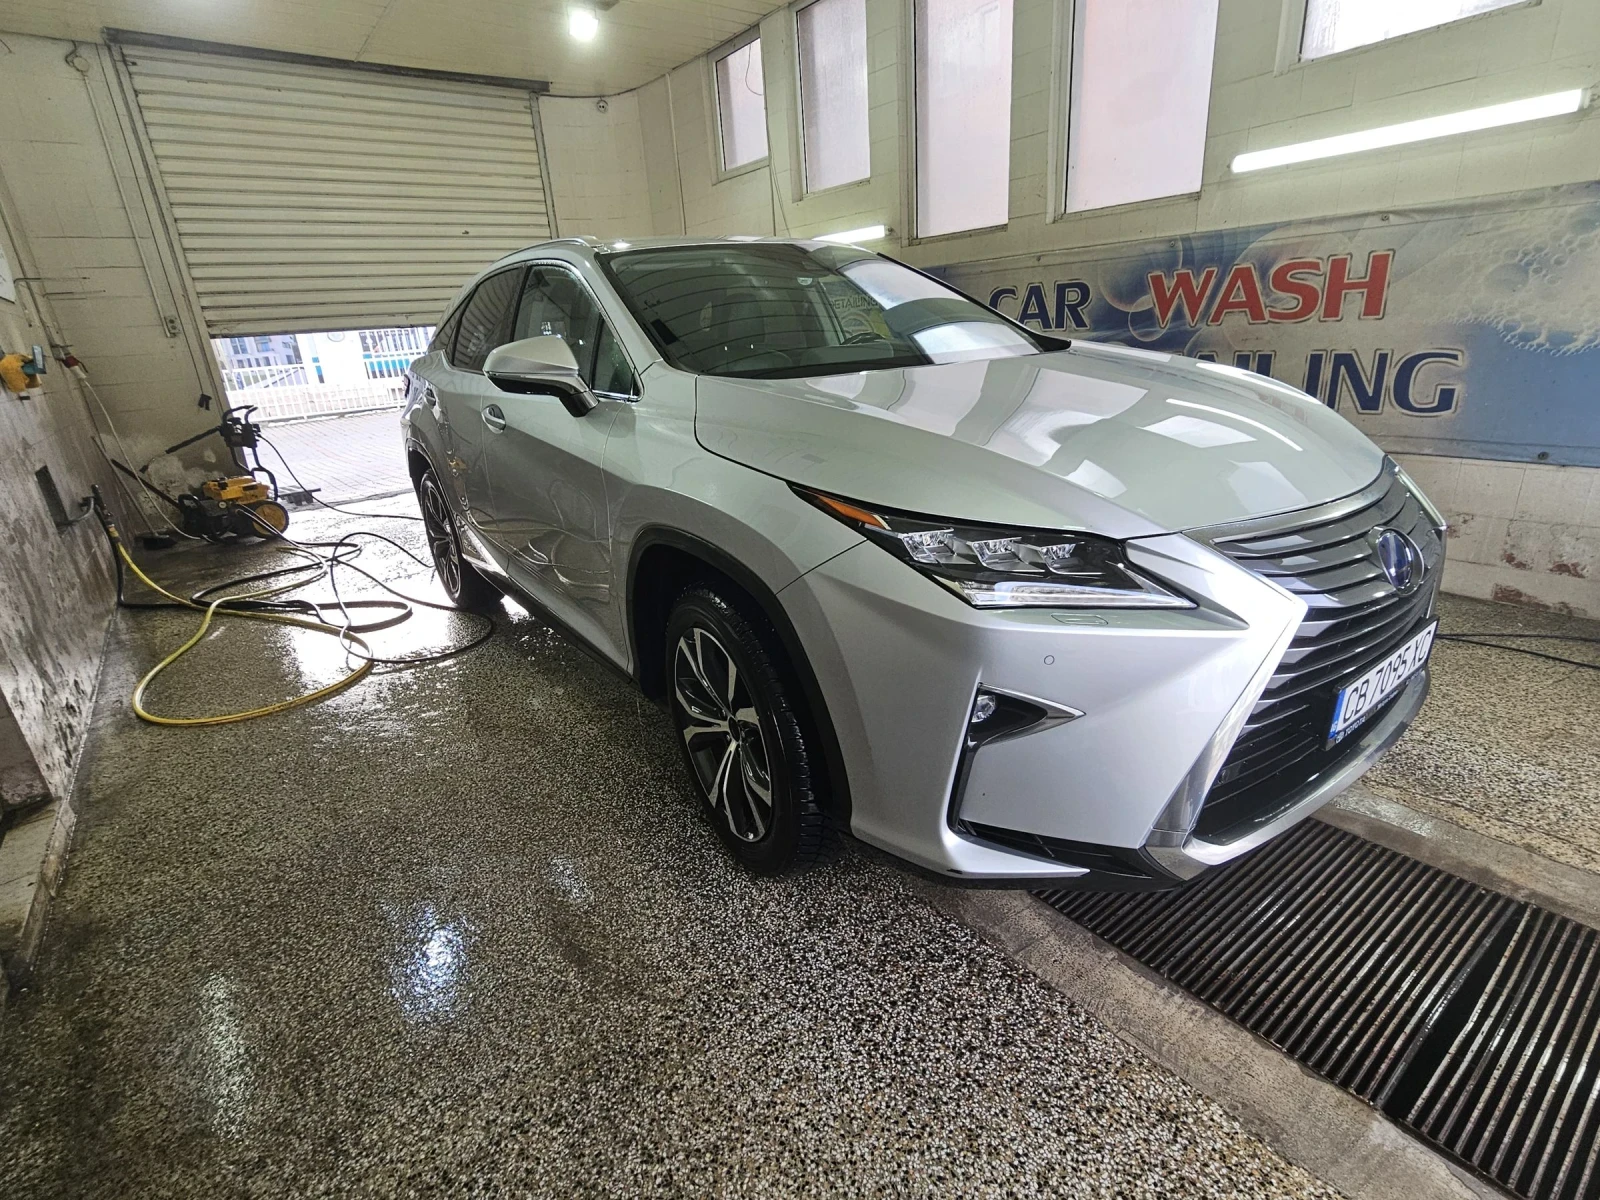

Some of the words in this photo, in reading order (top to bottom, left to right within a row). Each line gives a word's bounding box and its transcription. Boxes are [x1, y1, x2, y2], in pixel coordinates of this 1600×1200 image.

[988, 280, 1092, 332] CAR
[1147, 249, 1395, 329] WASH
[1343, 678, 1370, 724] CB
[1369, 646, 1411, 705] 7095
[1408, 629, 1432, 673] XC
